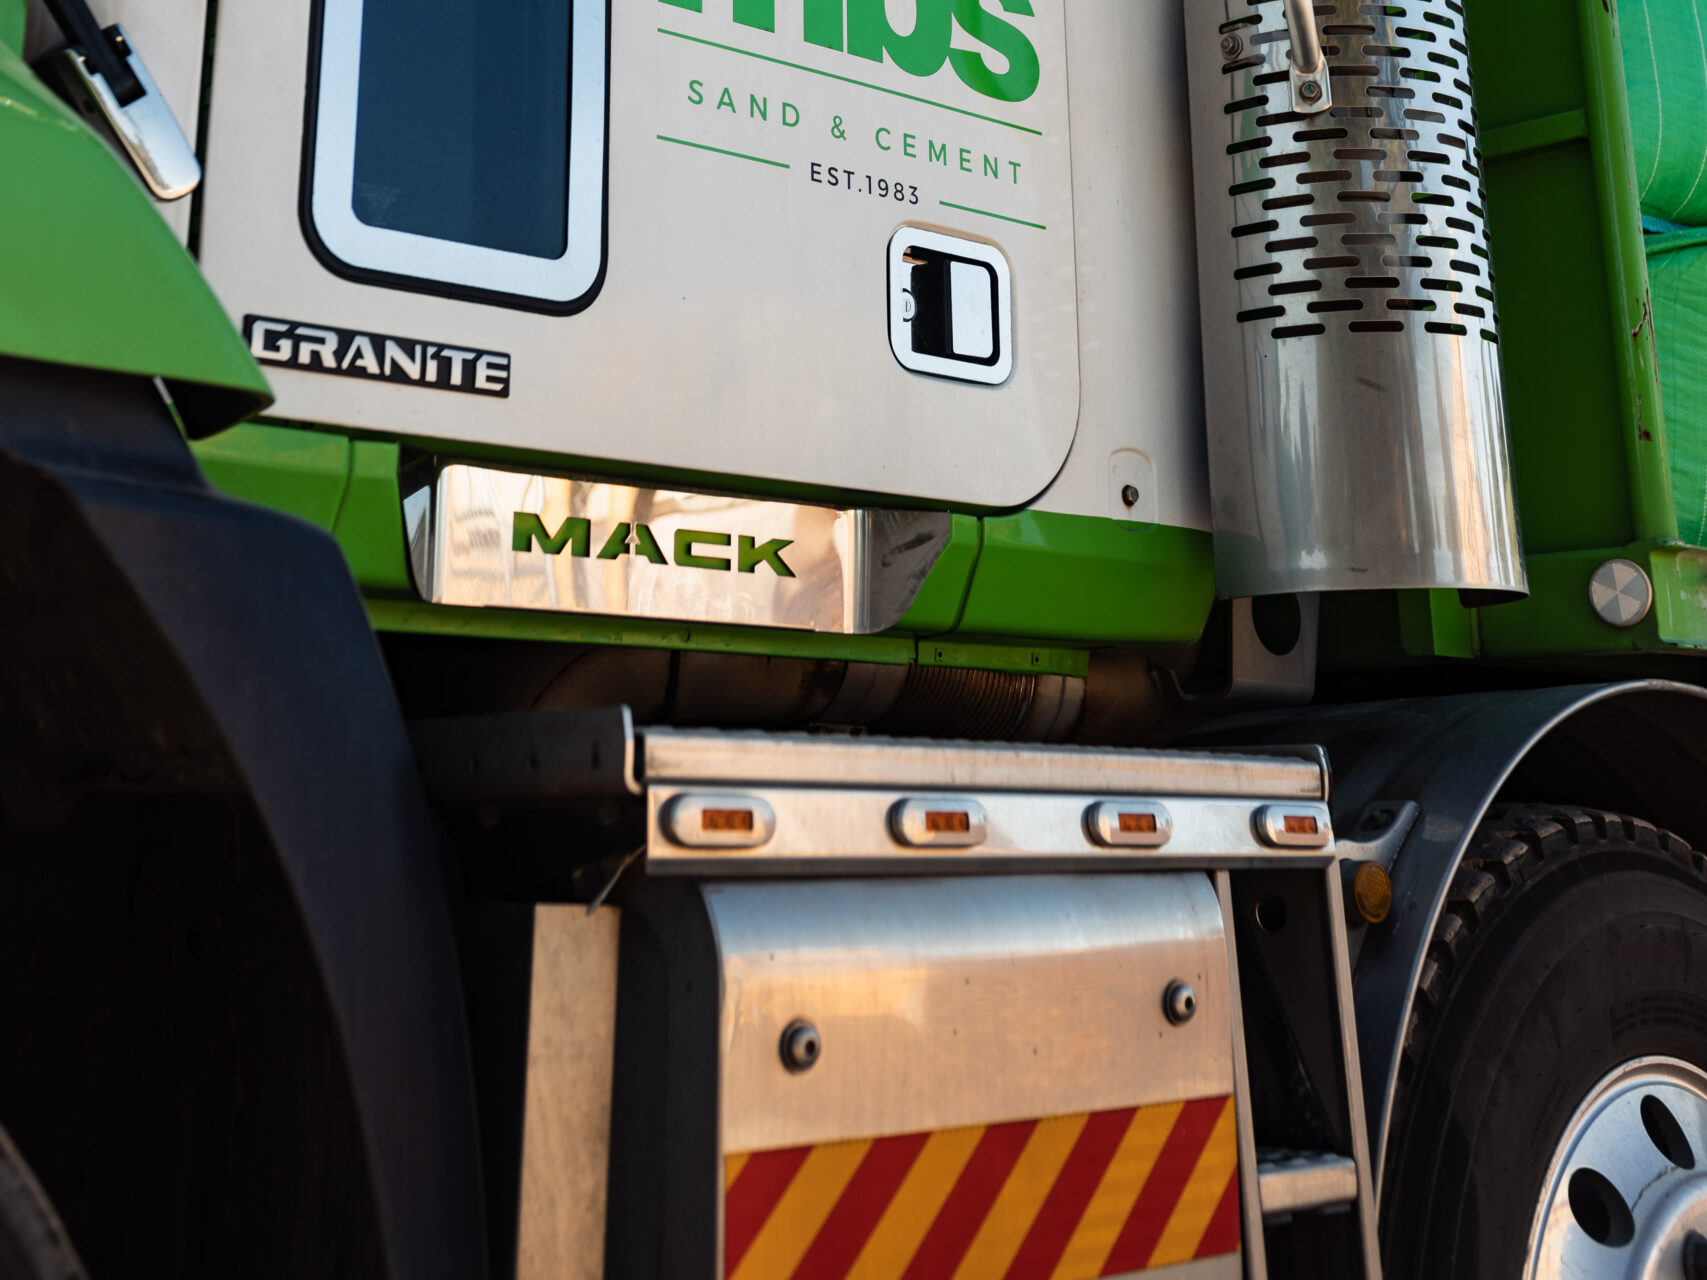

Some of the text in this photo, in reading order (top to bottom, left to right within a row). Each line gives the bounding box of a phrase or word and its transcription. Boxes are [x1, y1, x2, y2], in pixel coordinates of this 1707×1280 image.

[687, 79, 1022, 185] SAND & CEMENT
[810, 161, 919, 205] EST.1983
[250, 319, 509, 391] GRANITE
[511, 511, 796, 578] MACK
